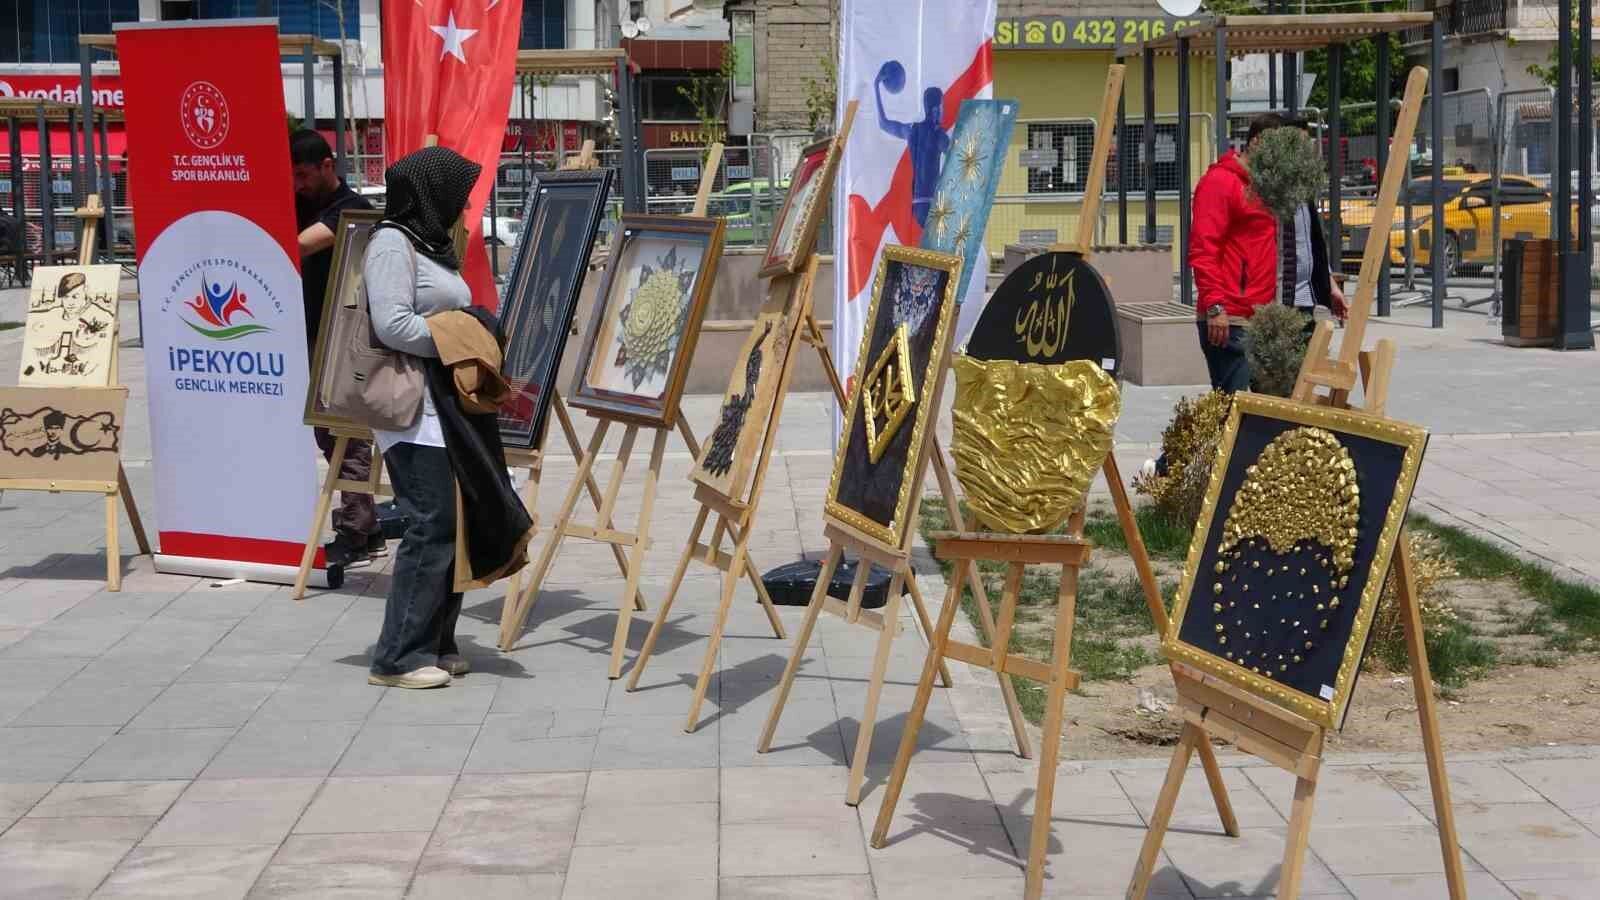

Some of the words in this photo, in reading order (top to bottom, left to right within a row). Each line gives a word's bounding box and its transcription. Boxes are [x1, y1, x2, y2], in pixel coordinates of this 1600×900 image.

[1052, 20, 1066, 44] 0
[1072, 20, 1117, 44] 432
[1123, 20, 1166, 44] 216
[173, 155, 191, 166] T.C.
[191, 153, 233, 169] GENÇLİK
[233, 155, 246, 166] VE
[172, 169, 197, 181] SPOR
[197, 168, 250, 182] BAKANLIĞI
[168, 346, 284, 376] İPEKYOLU
